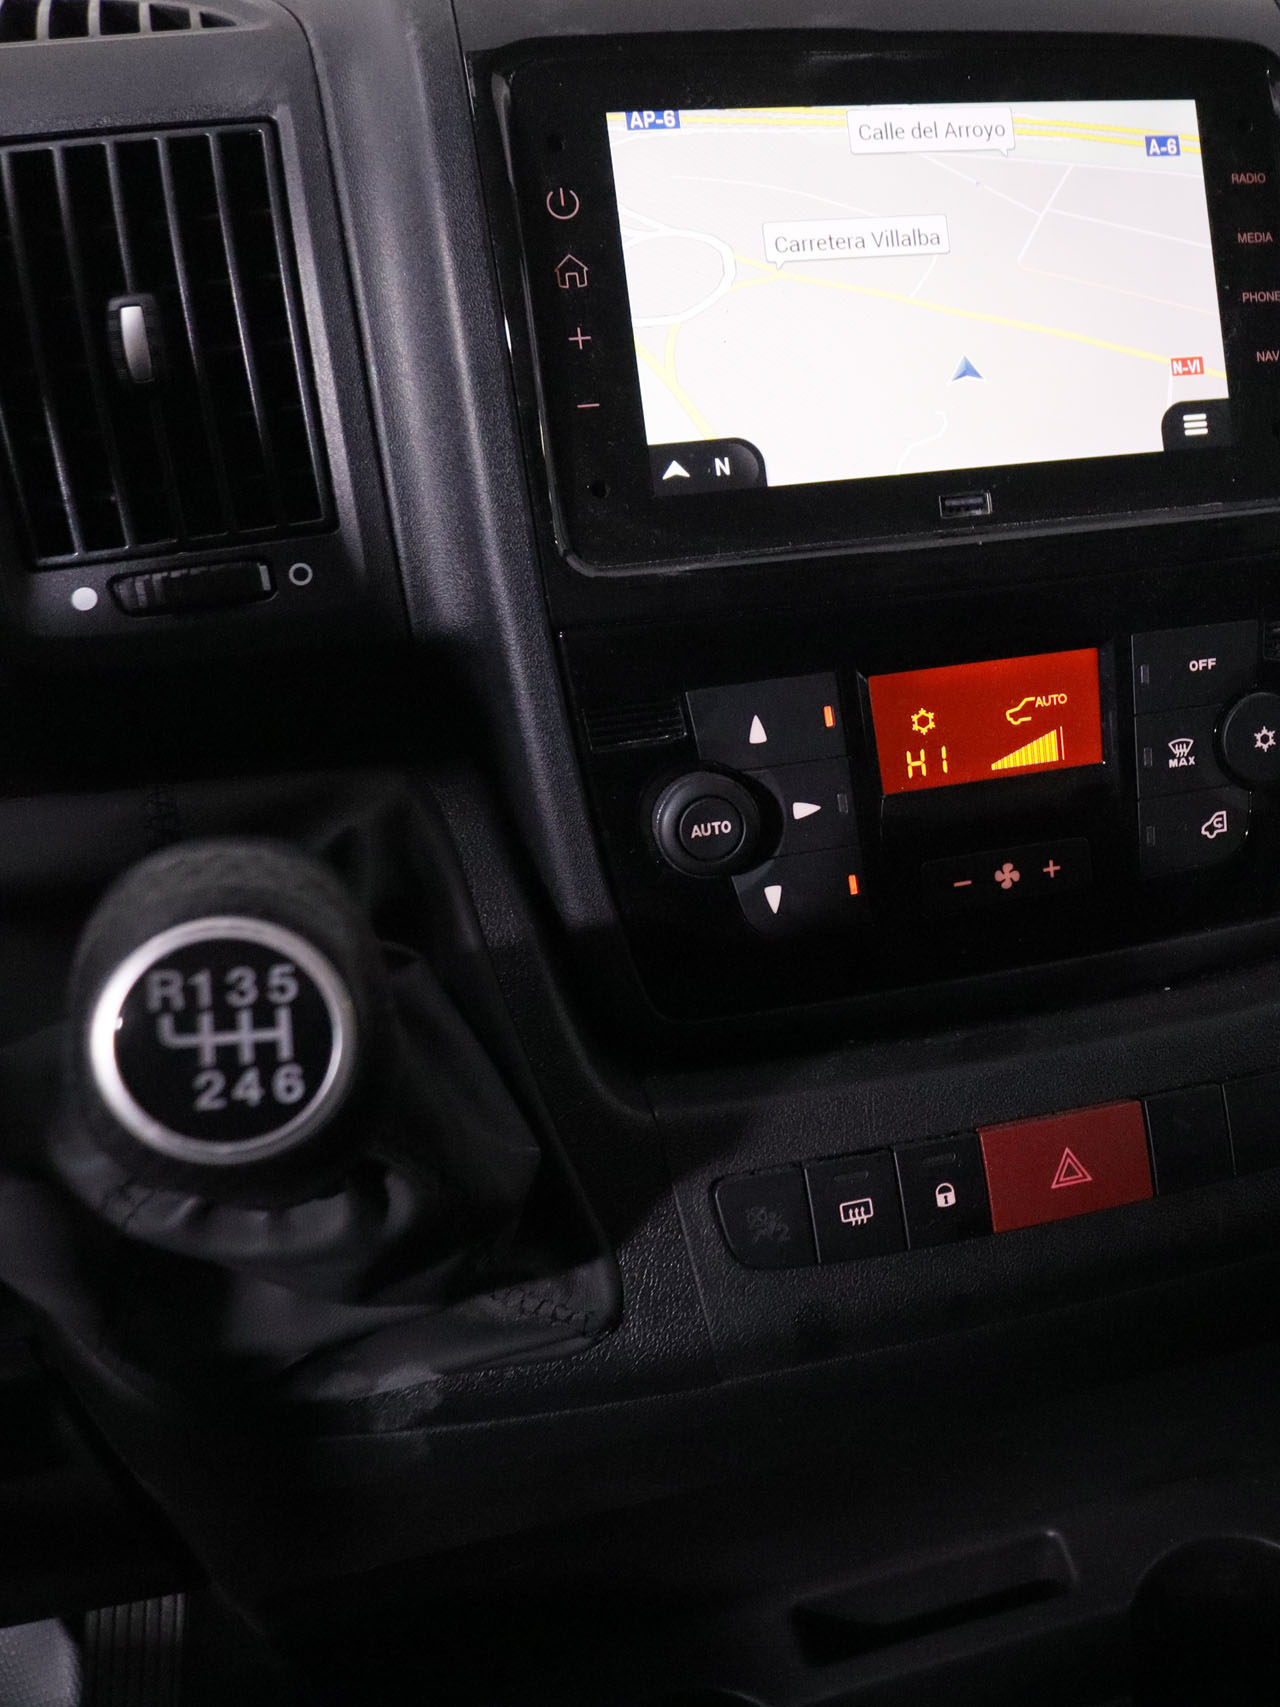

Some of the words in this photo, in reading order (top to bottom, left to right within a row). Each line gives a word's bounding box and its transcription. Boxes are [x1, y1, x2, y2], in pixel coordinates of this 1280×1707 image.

[629, 110, 677, 130] AP-6
[858, 121, 906, 141] Calle
[911, 121, 939, 140] del
[944, 121, 1006, 142] Arroyo
[1149, 137, 1178, 156] A-6
[1231, 172, 1266, 185] RADIO
[774, 233, 866, 254] Carretera
[870, 227, 942, 249] Villalba
[1237, 231, 1274, 244] MEDIA
[1256, 350, 1280, 363] NAV
[1171, 358, 1202, 375] N-VI
[714, 456, 731, 477] N
[1188, 657, 1217, 672] OFF
[1034, 693, 1068, 708] AUTO
[1168, 755, 1196, 769] MAX
[690, 820, 732, 839] AUTO
[148, 968, 185, 1012] R
[187, 968, 213, 1008] 1
[225, 965, 258, 1007] 3
[266, 962, 299, 1004] 5
[192, 1069, 227, 1111] 2
[231, 1066, 264, 1107] 4
[272, 1062, 305, 1105] 6
